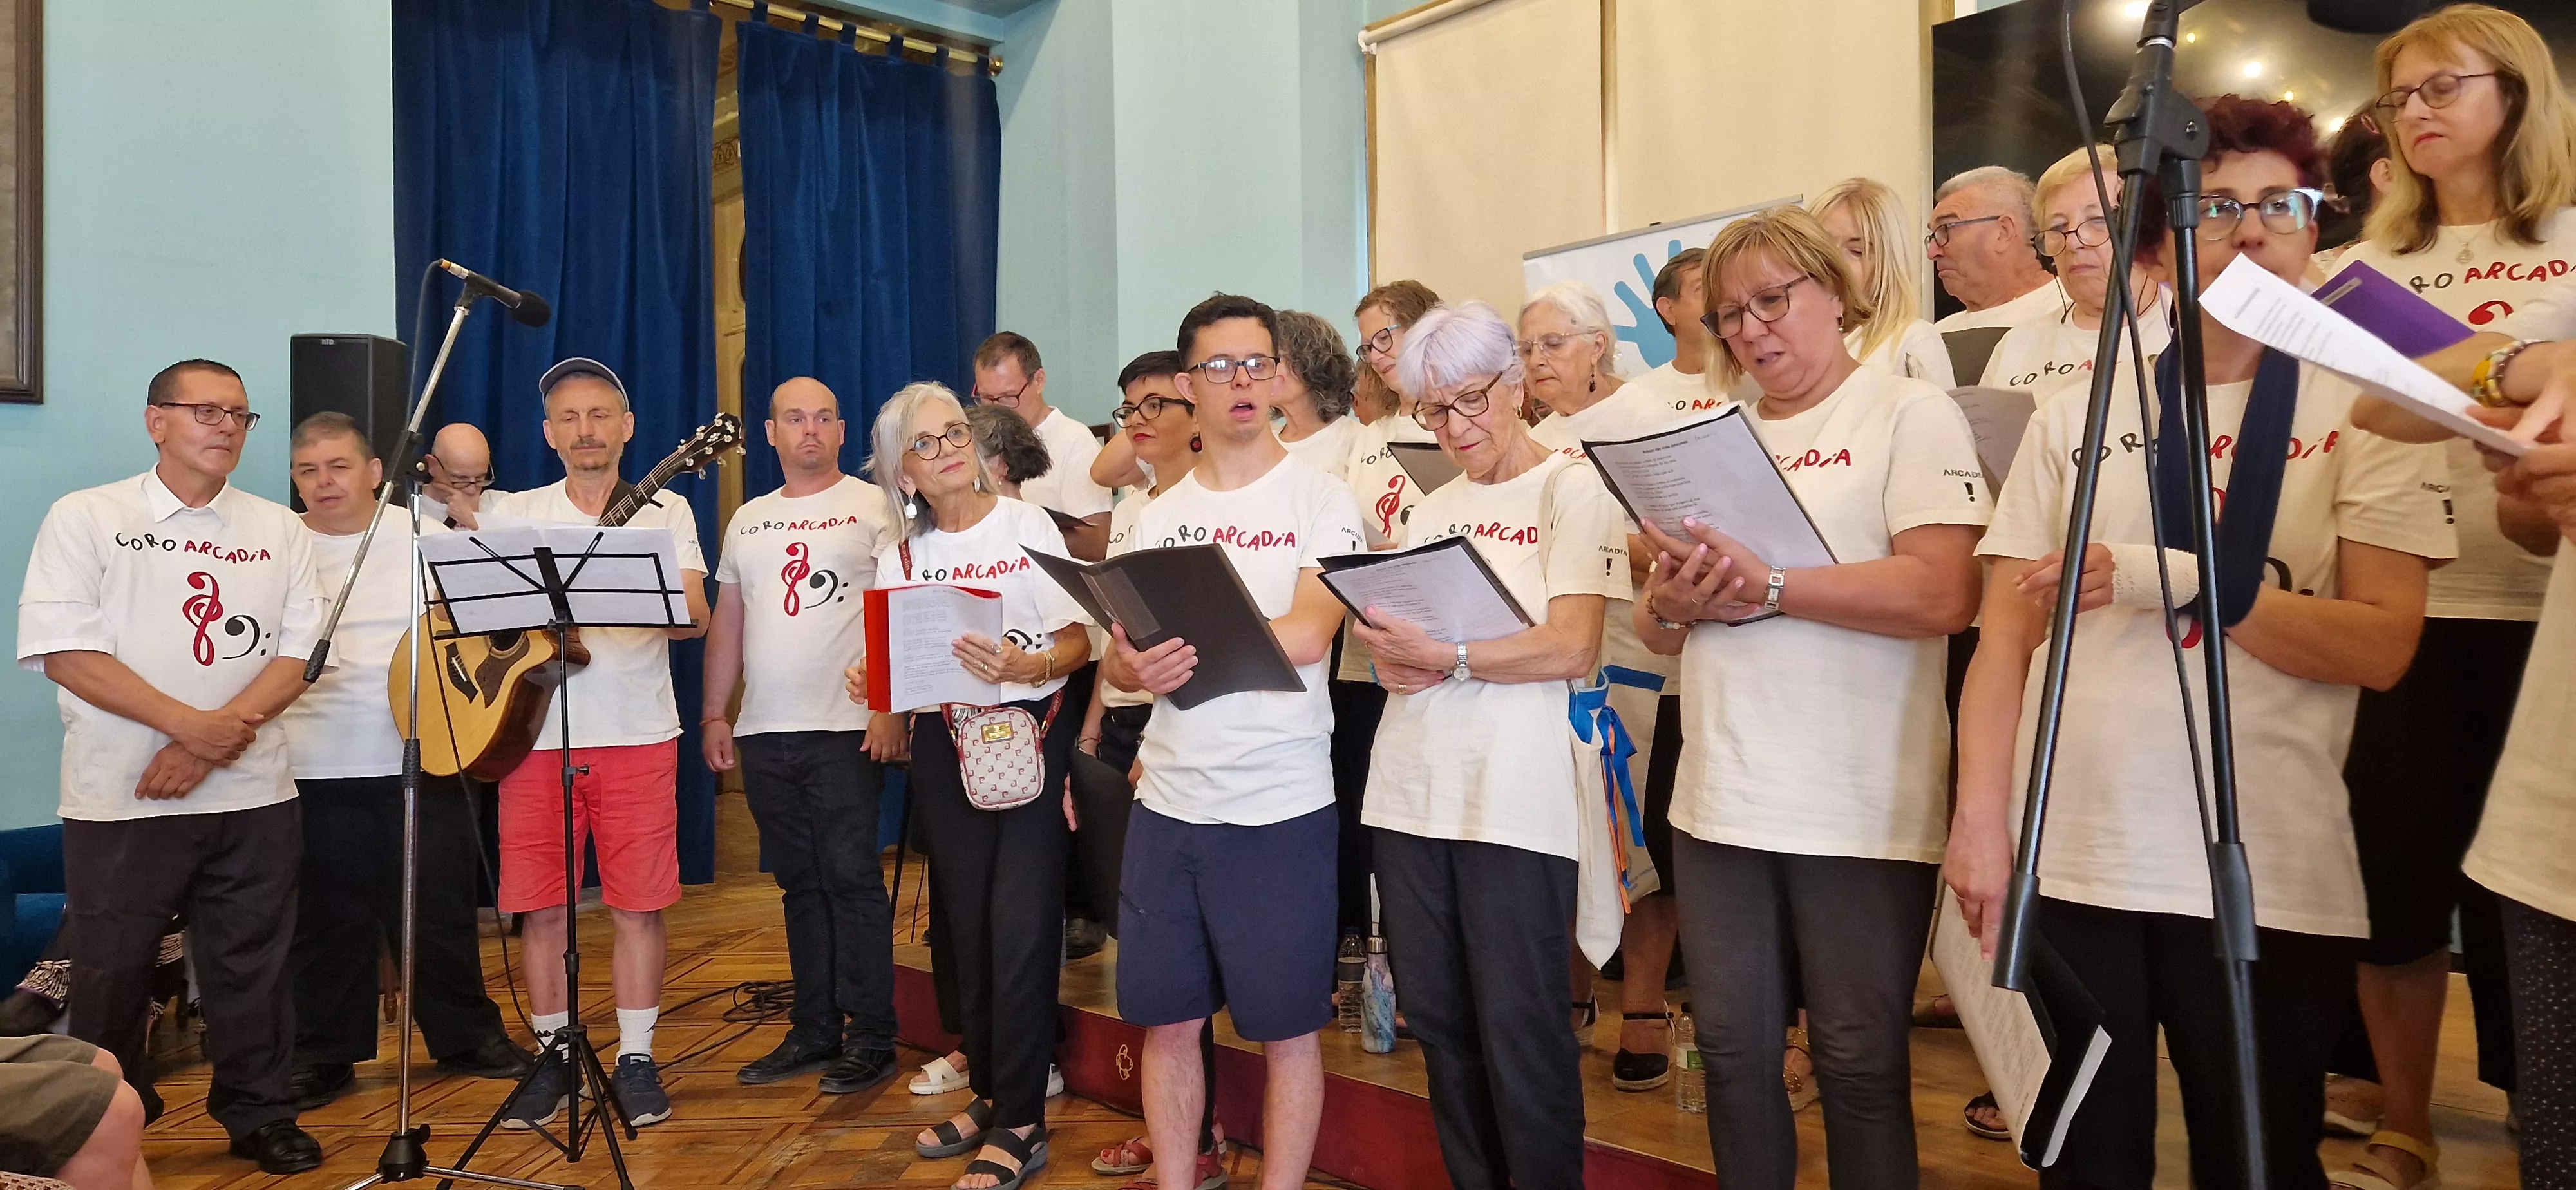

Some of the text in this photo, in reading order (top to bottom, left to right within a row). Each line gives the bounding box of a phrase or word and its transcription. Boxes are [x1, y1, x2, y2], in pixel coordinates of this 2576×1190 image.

[2009, 361, 2074, 386] CORO
[740, 520, 785, 536] CORO
[115, 532, 177, 551] CORO
